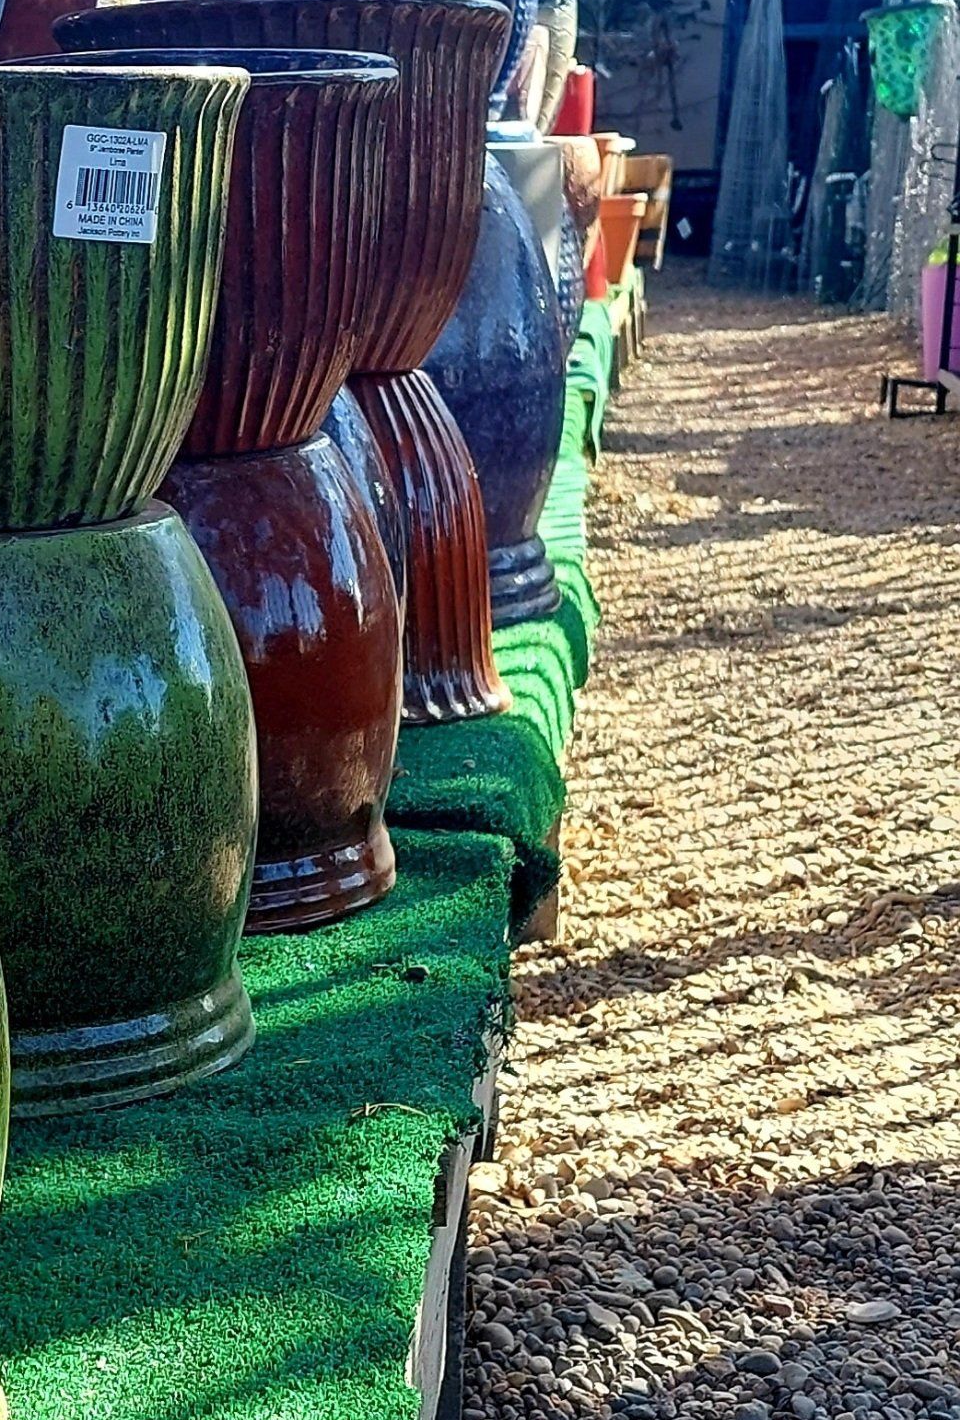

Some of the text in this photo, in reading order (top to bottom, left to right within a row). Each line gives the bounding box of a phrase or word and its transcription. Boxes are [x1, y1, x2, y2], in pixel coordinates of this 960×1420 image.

[67, 200, 73, 209] 6
[79, 214, 143, 226] MADE IN CHINA
[108, 229, 130, 238] Pottery
